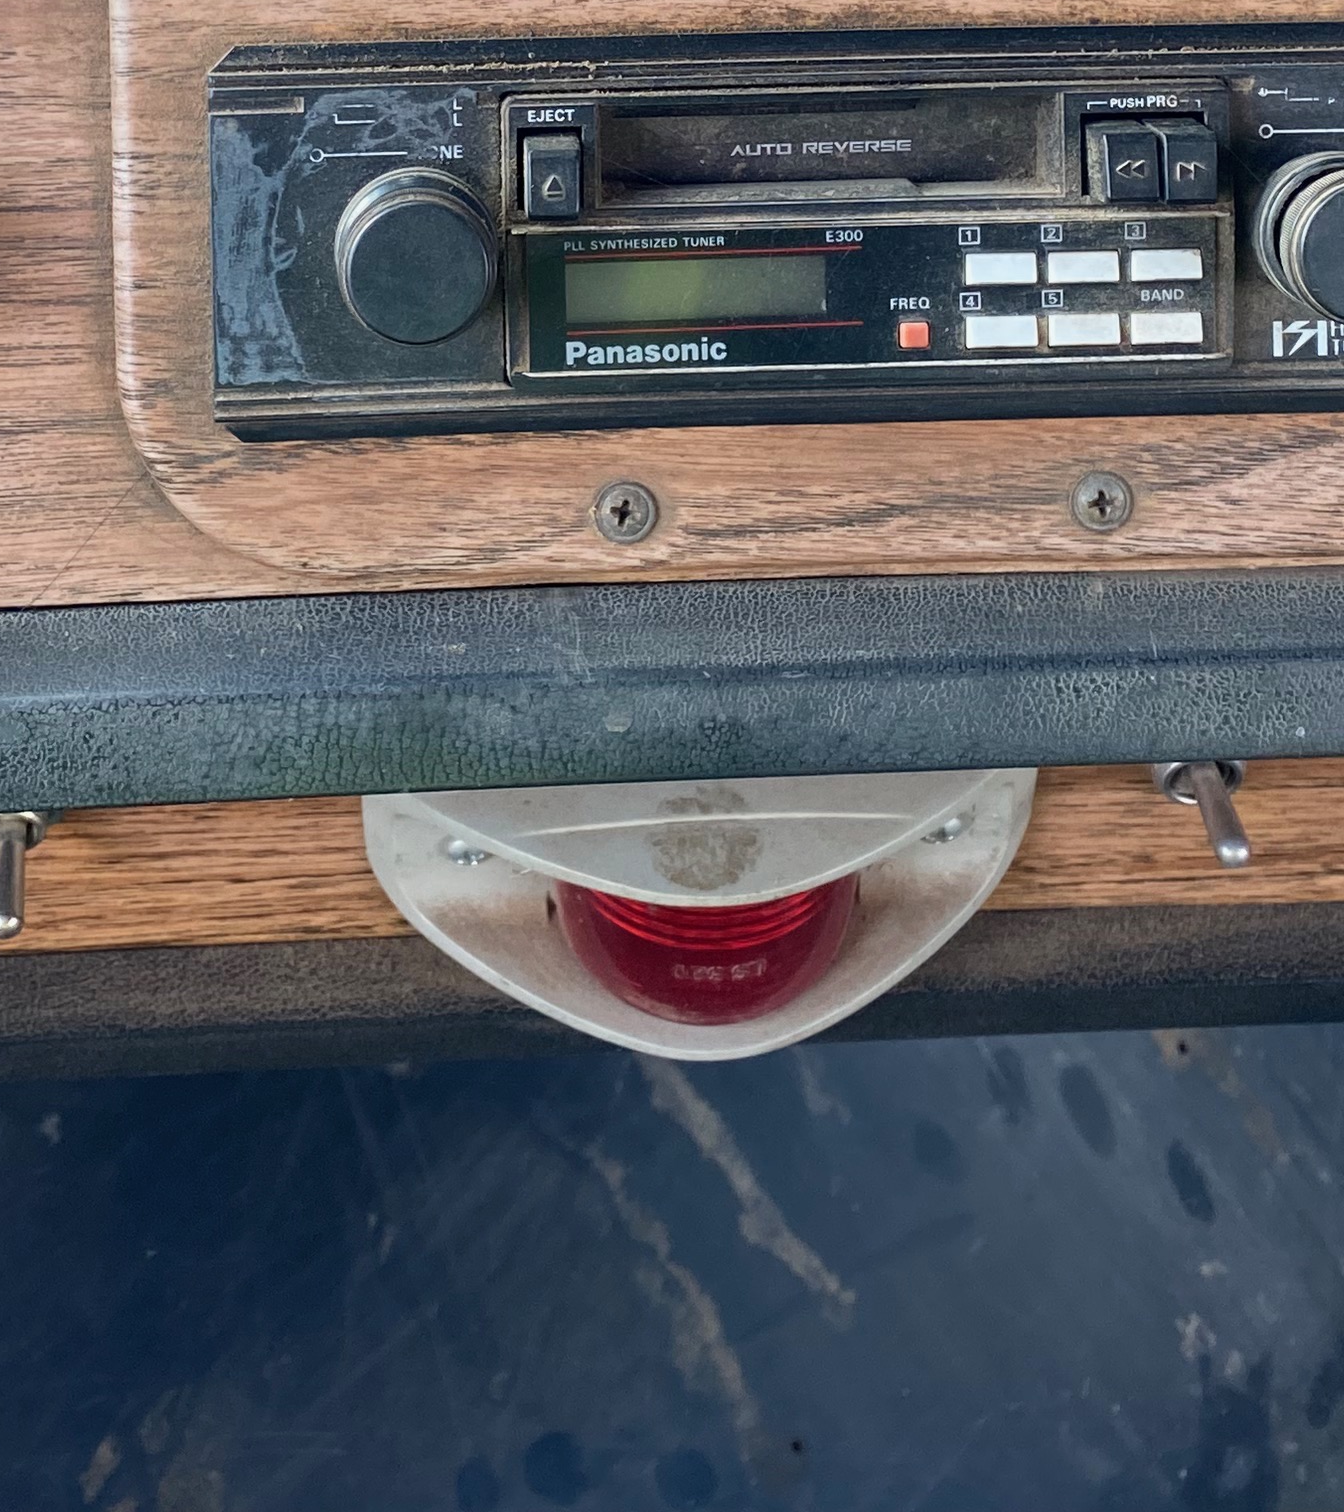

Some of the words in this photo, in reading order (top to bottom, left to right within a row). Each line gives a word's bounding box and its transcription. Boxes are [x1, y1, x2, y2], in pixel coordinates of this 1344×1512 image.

[1110, 97, 1144, 109] PUSH
[1146, 94, 1178, 109] PRG
[527, 109, 575, 123] EJECT
[730, 143, 792, 157] AUTO
[802, 139, 912, 156] REVERSE
[825, 229, 863, 243] E300
[564, 240, 585, 252] PLL
[590, 237, 678, 251] SYNTHESIZED
[682, 235, 725, 248] TUNER
[1140, 289, 1185, 302] BAND
[889, 297, 931, 311] FREQ
[565, 337, 728, 366] Panasonic
